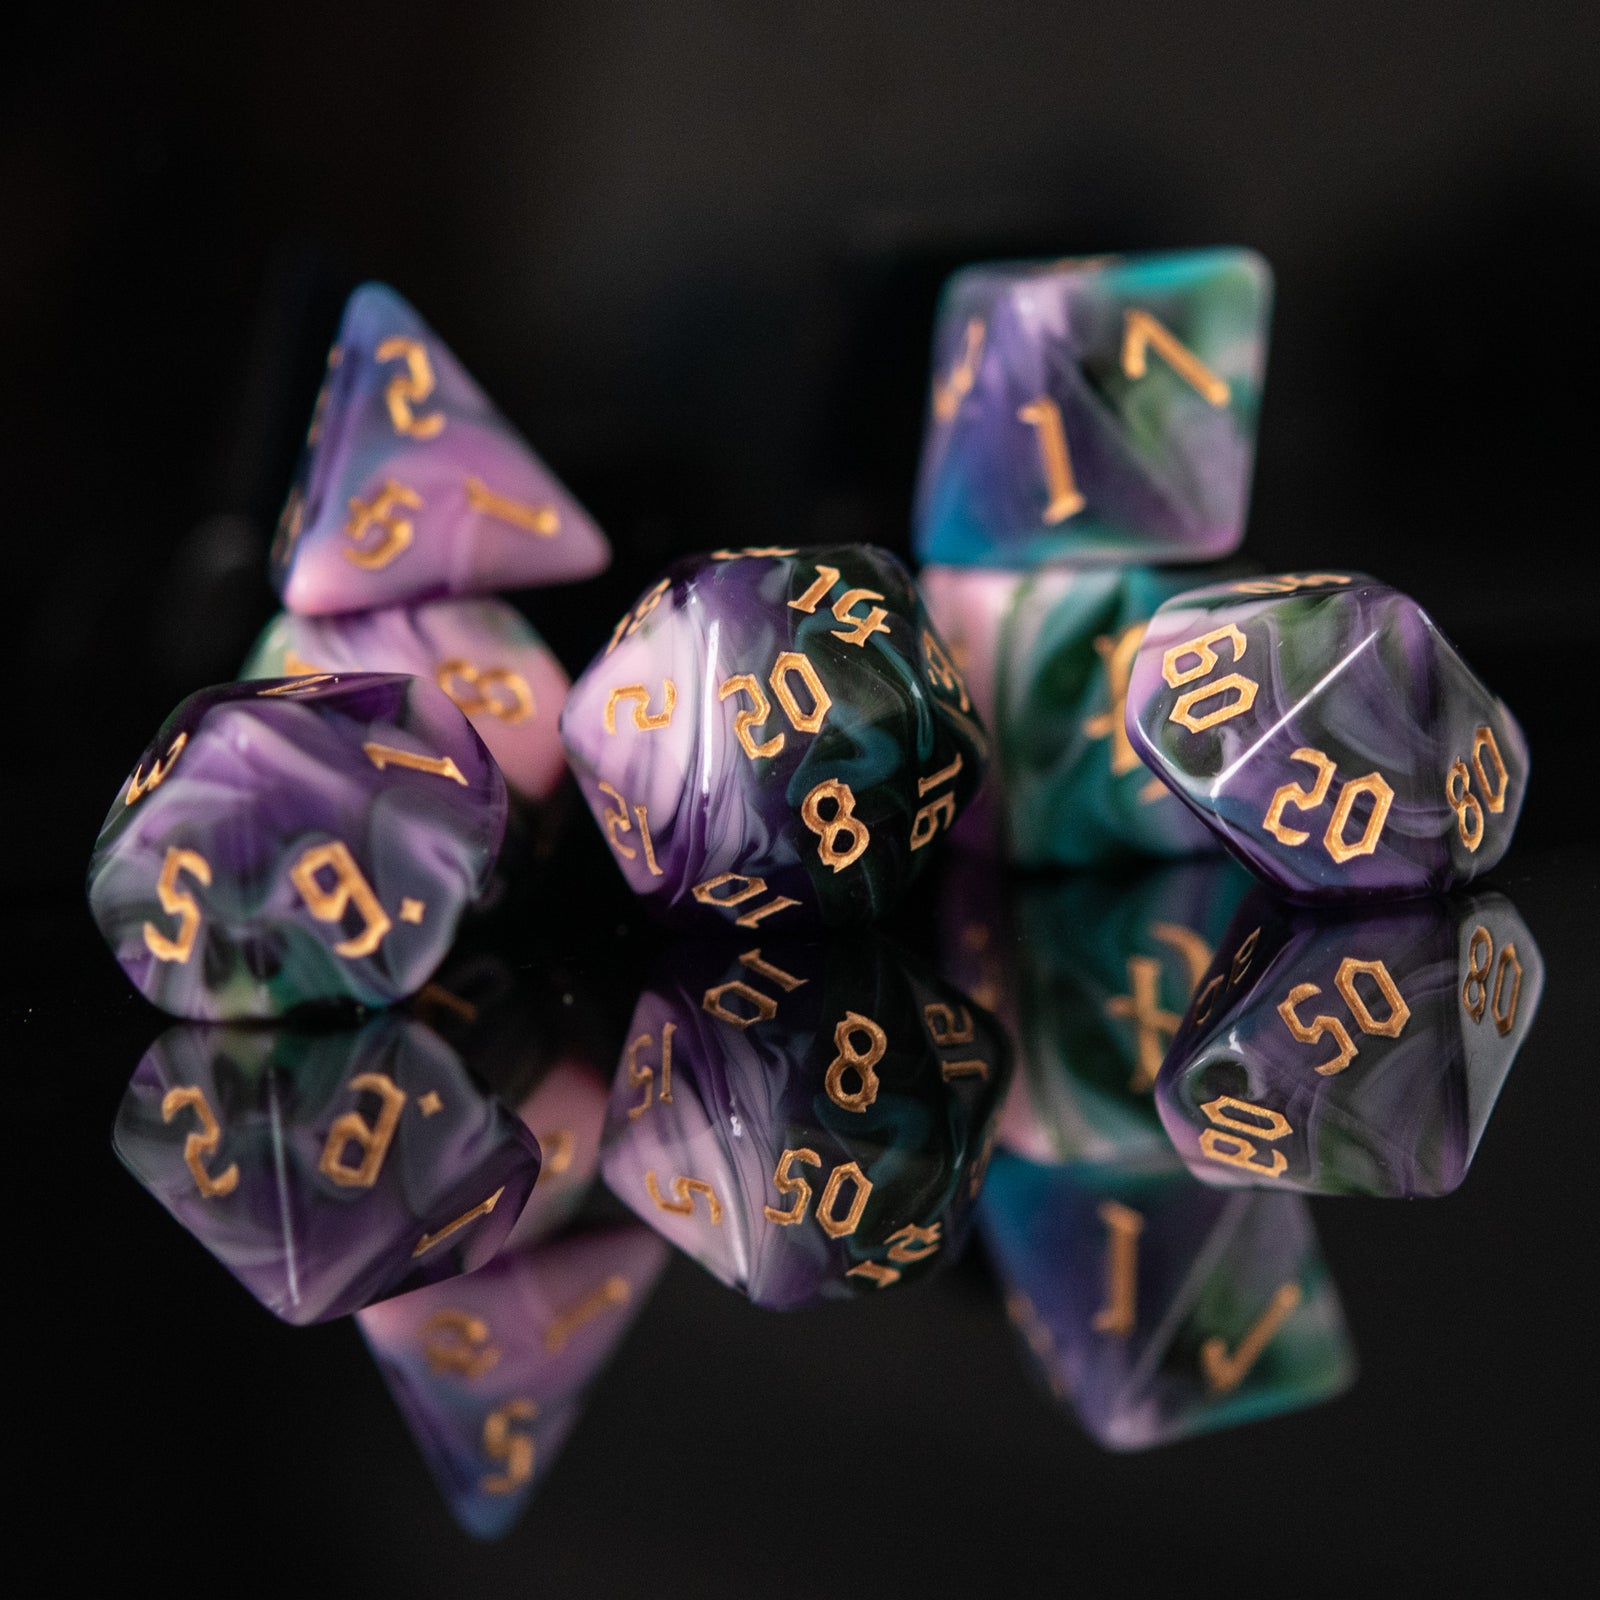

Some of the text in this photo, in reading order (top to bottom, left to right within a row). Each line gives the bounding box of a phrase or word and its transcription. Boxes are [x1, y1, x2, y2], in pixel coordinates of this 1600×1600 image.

[375, 335, 447, 440] 2
[1017, 395, 1086, 526] 1
[788, 564, 891, 647] 14
[435, 658, 540, 724] 8
[719, 651, 833, 760] 20
[801, 777, 870, 874] 8
[1262, 747, 1395, 865] 20
[1446, 726, 1509, 853] 80
[692, 872, 803, 929] 10
